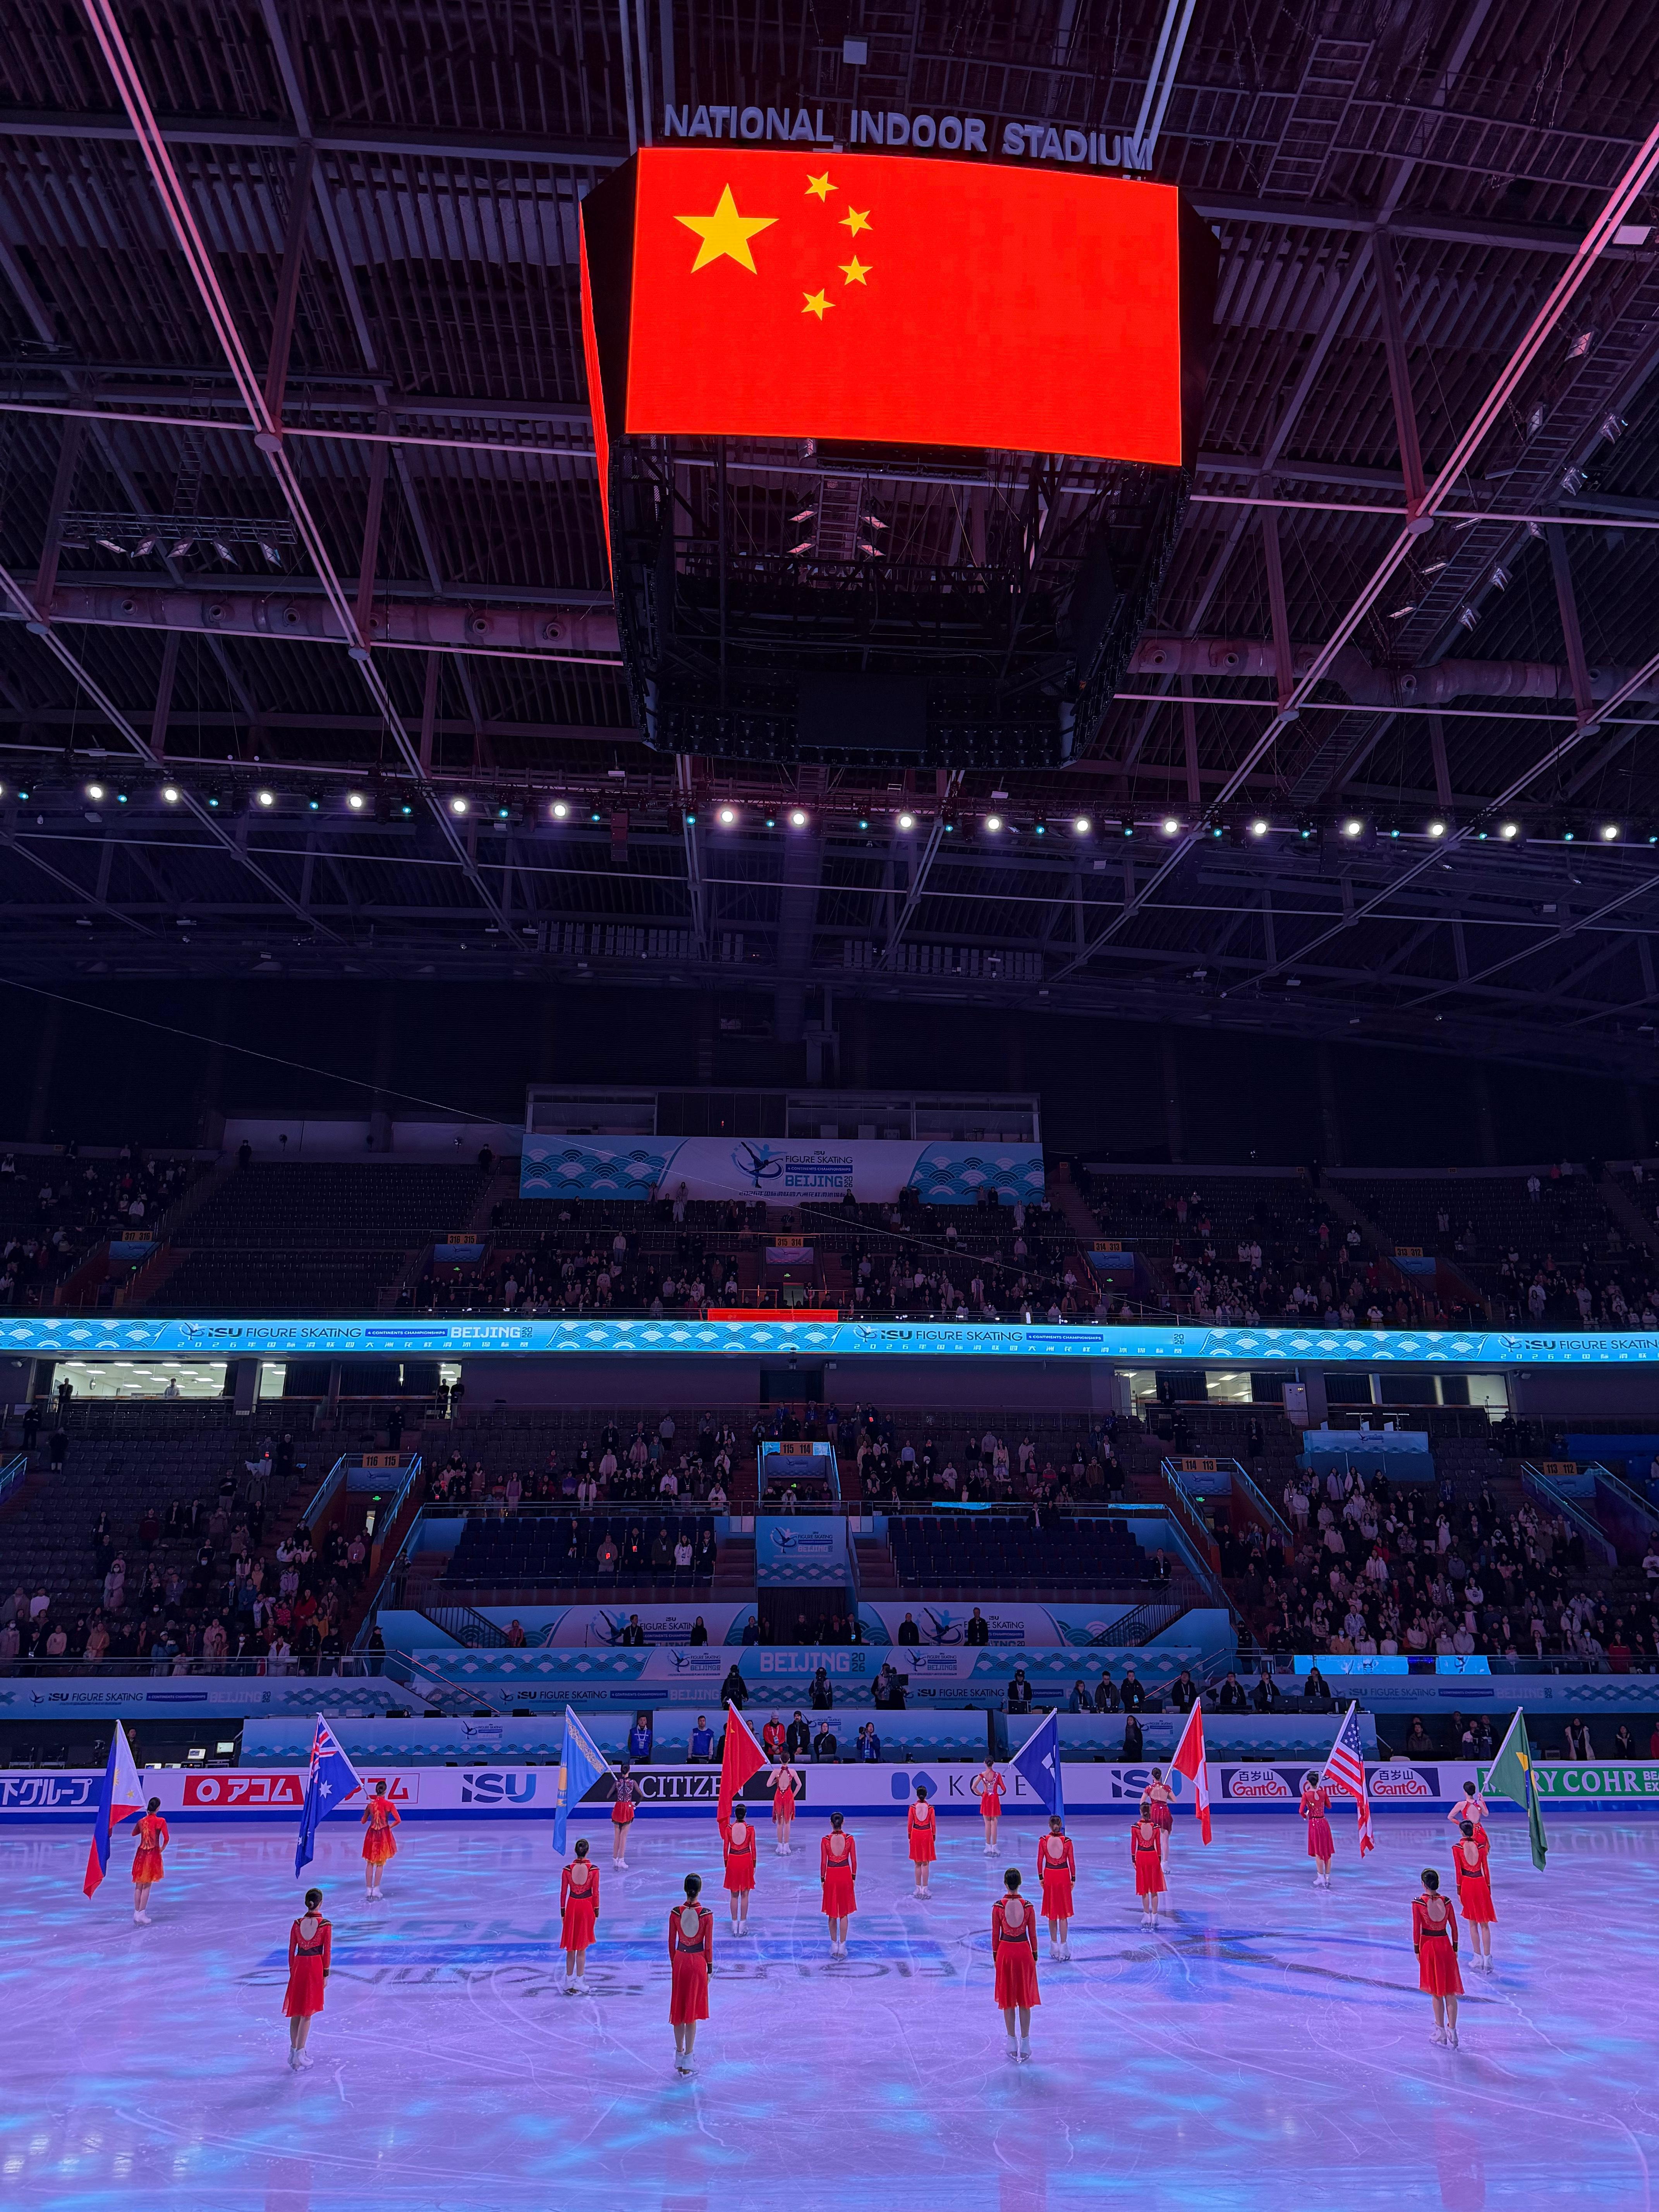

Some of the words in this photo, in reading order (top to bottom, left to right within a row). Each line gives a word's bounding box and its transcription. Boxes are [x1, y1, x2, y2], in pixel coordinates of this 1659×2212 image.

[665, 104, 834, 143] NATIONAL
[852, 110, 987, 152] INDOOR
[1002, 122, 1153, 171] STADIUM
[785, 1175, 843, 1187] BEIJING
[125, 1232, 136, 1240] 317
[139, 1232, 150, 1241] 316
[1096, 1242, 1106, 1250] 314
[1397, 1248, 1408, 1256] 313
[1411, 1248, 1422, 1256] 312
[208, 1328, 243, 1338] ISU
[246, 1328, 297, 1338] FIGURE
[301, 1328, 361, 1338] SKATING
[450, 1327, 520, 1338] BEIJING
[881, 1330, 912, 1340] ISU
[916, 1330, 963, 1341] FIGURE
[967, 1331, 1023, 1341] SKATING
[1525, 1340, 1556, 1350] ISU
[1560, 1340, 1607, 1350] FIGURE
[1611, 1339, 1659, 1349] SKATIN
[783, 1444, 794, 1454] 115
[799, 1444, 811, 1454] 114
[366, 1456, 378, 1467] 116
[384, 1455, 397, 1466] 115
[1185, 1460, 1197, 1470] 114
[1202, 1460, 1214, 1470] 113
[1546, 1464, 1558, 1474] 113
[1563, 1464, 1574, 1474] 112
[761, 1652, 850, 1672] BEIJING
[852, 1652, 865, 1662] 20
[852, 1662, 865, 1672] 26
[48, 1693, 69, 1701] ISU
[72, 1693, 104, 1701] FIGURE
[105, 1693, 143, 1701] SKATING
[209, 1692, 261, 1703] BEIJING
[517, 1691, 537, 1699] ISU
[540, 1691, 569, 1699] FIGURE
[572, 1691, 607, 1699] SKATING
[670, 1689, 720, 1700] BEIJING
[918, 1688, 936, 1697] ISU
[939, 1688, 968, 1697] FIGURE
[970, 1688, 1005, 1697] SKATING
[1371, 1688, 1400, 1696] FIGURE
[1401, 1688, 1436, 1697] SKATING
[1238, 1771, 1273, 1781] 百岁山
[1379, 1770, 1413, 1781] 百岁山
[639, 1776, 744, 1798] CITIZE
[1373, 1780, 1427, 1795] Ganten
[1563, 1771, 1642, 1793] COHR
[0, 1778, 93, 1805] 下グループ
[228, 1778, 293, 1802] アコム
[462, 1773, 537, 1803] ISU
[1232, 1781, 1287, 1796] Ganten
